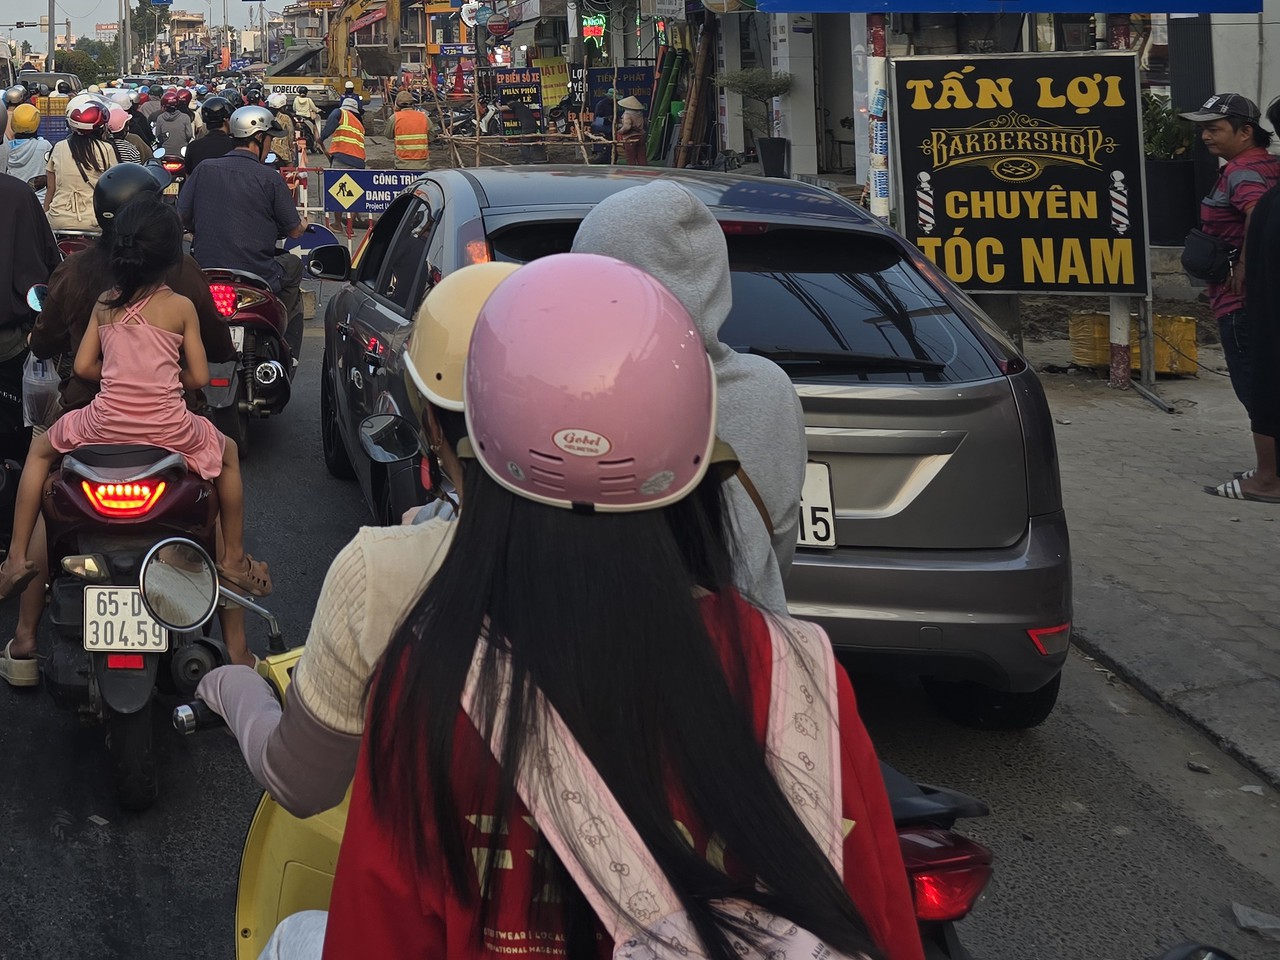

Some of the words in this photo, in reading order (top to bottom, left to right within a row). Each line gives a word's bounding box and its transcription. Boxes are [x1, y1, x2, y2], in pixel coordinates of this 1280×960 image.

[531, 72, 540, 82] XE
[906, 65, 1013, 110] TẤN
[1036, 73, 1125, 114] LỢI
[931, 129, 1105, 168] BARBERSHOP
[373, 173, 398, 184] CÔNG
[400, 173, 420, 185] TRÌN
[366, 202, 384, 211] Project
[945, 184, 1098, 219] CHUYÊN
[917, 227, 1005, 283] TÓC
[1021, 237, 1135, 285] NAM
[96, 591, 150, 617] 65-D
[89, 620, 163, 647] 304.59
